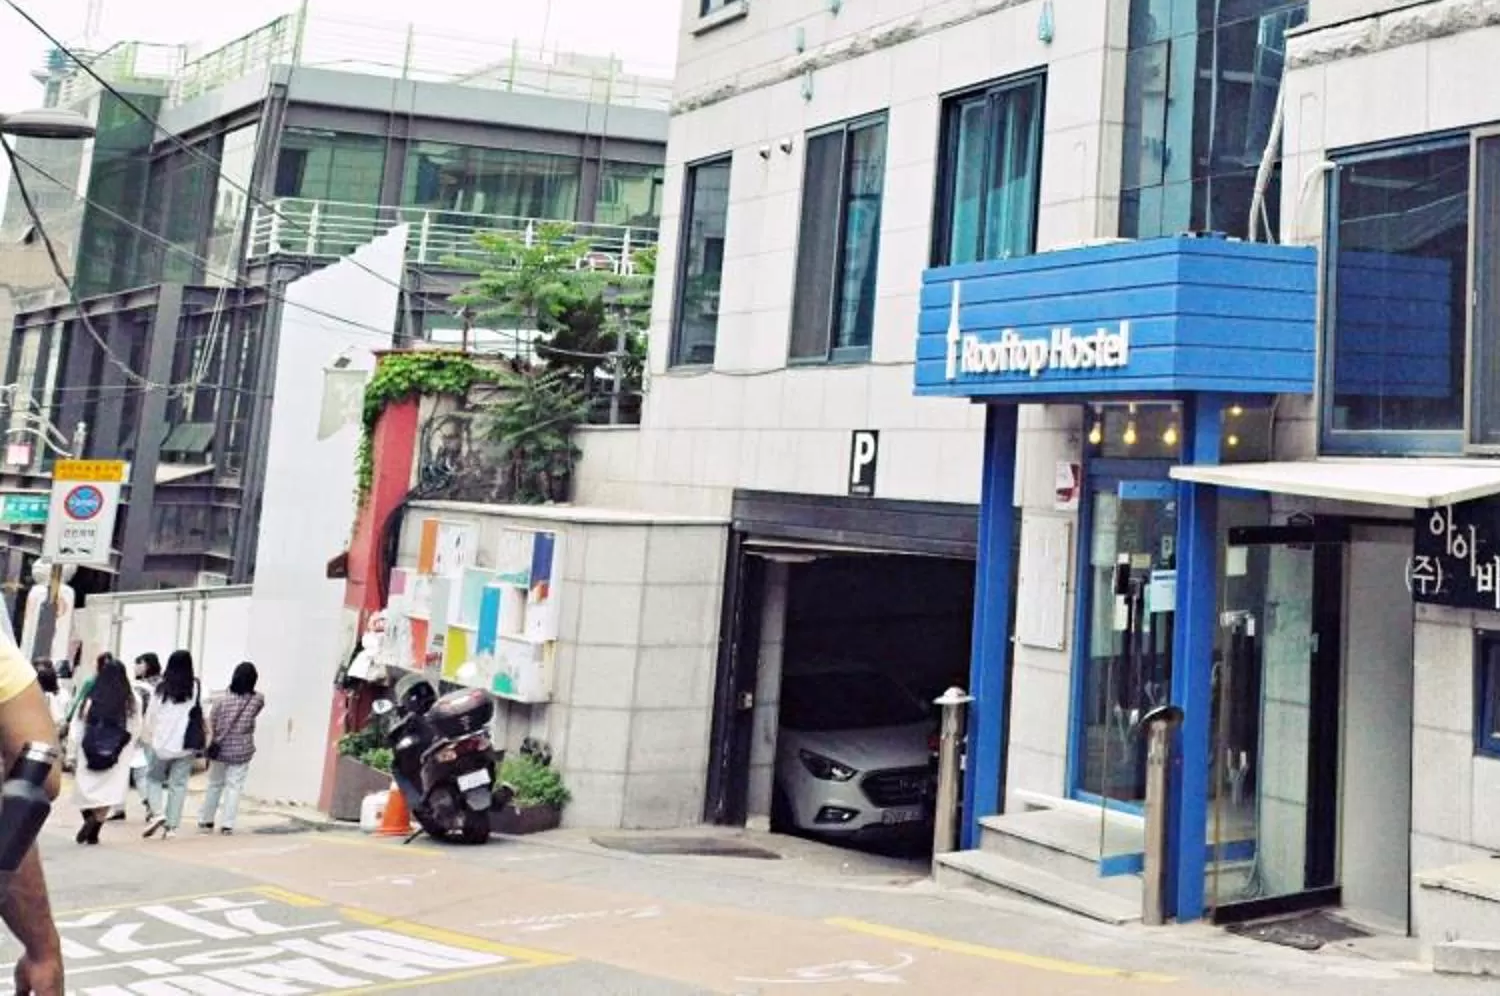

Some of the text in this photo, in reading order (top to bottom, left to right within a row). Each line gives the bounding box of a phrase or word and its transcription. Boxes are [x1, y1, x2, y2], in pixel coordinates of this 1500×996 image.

[961, 319, 1130, 378] Rooftop Hostel
[851, 431, 876, 484] P
